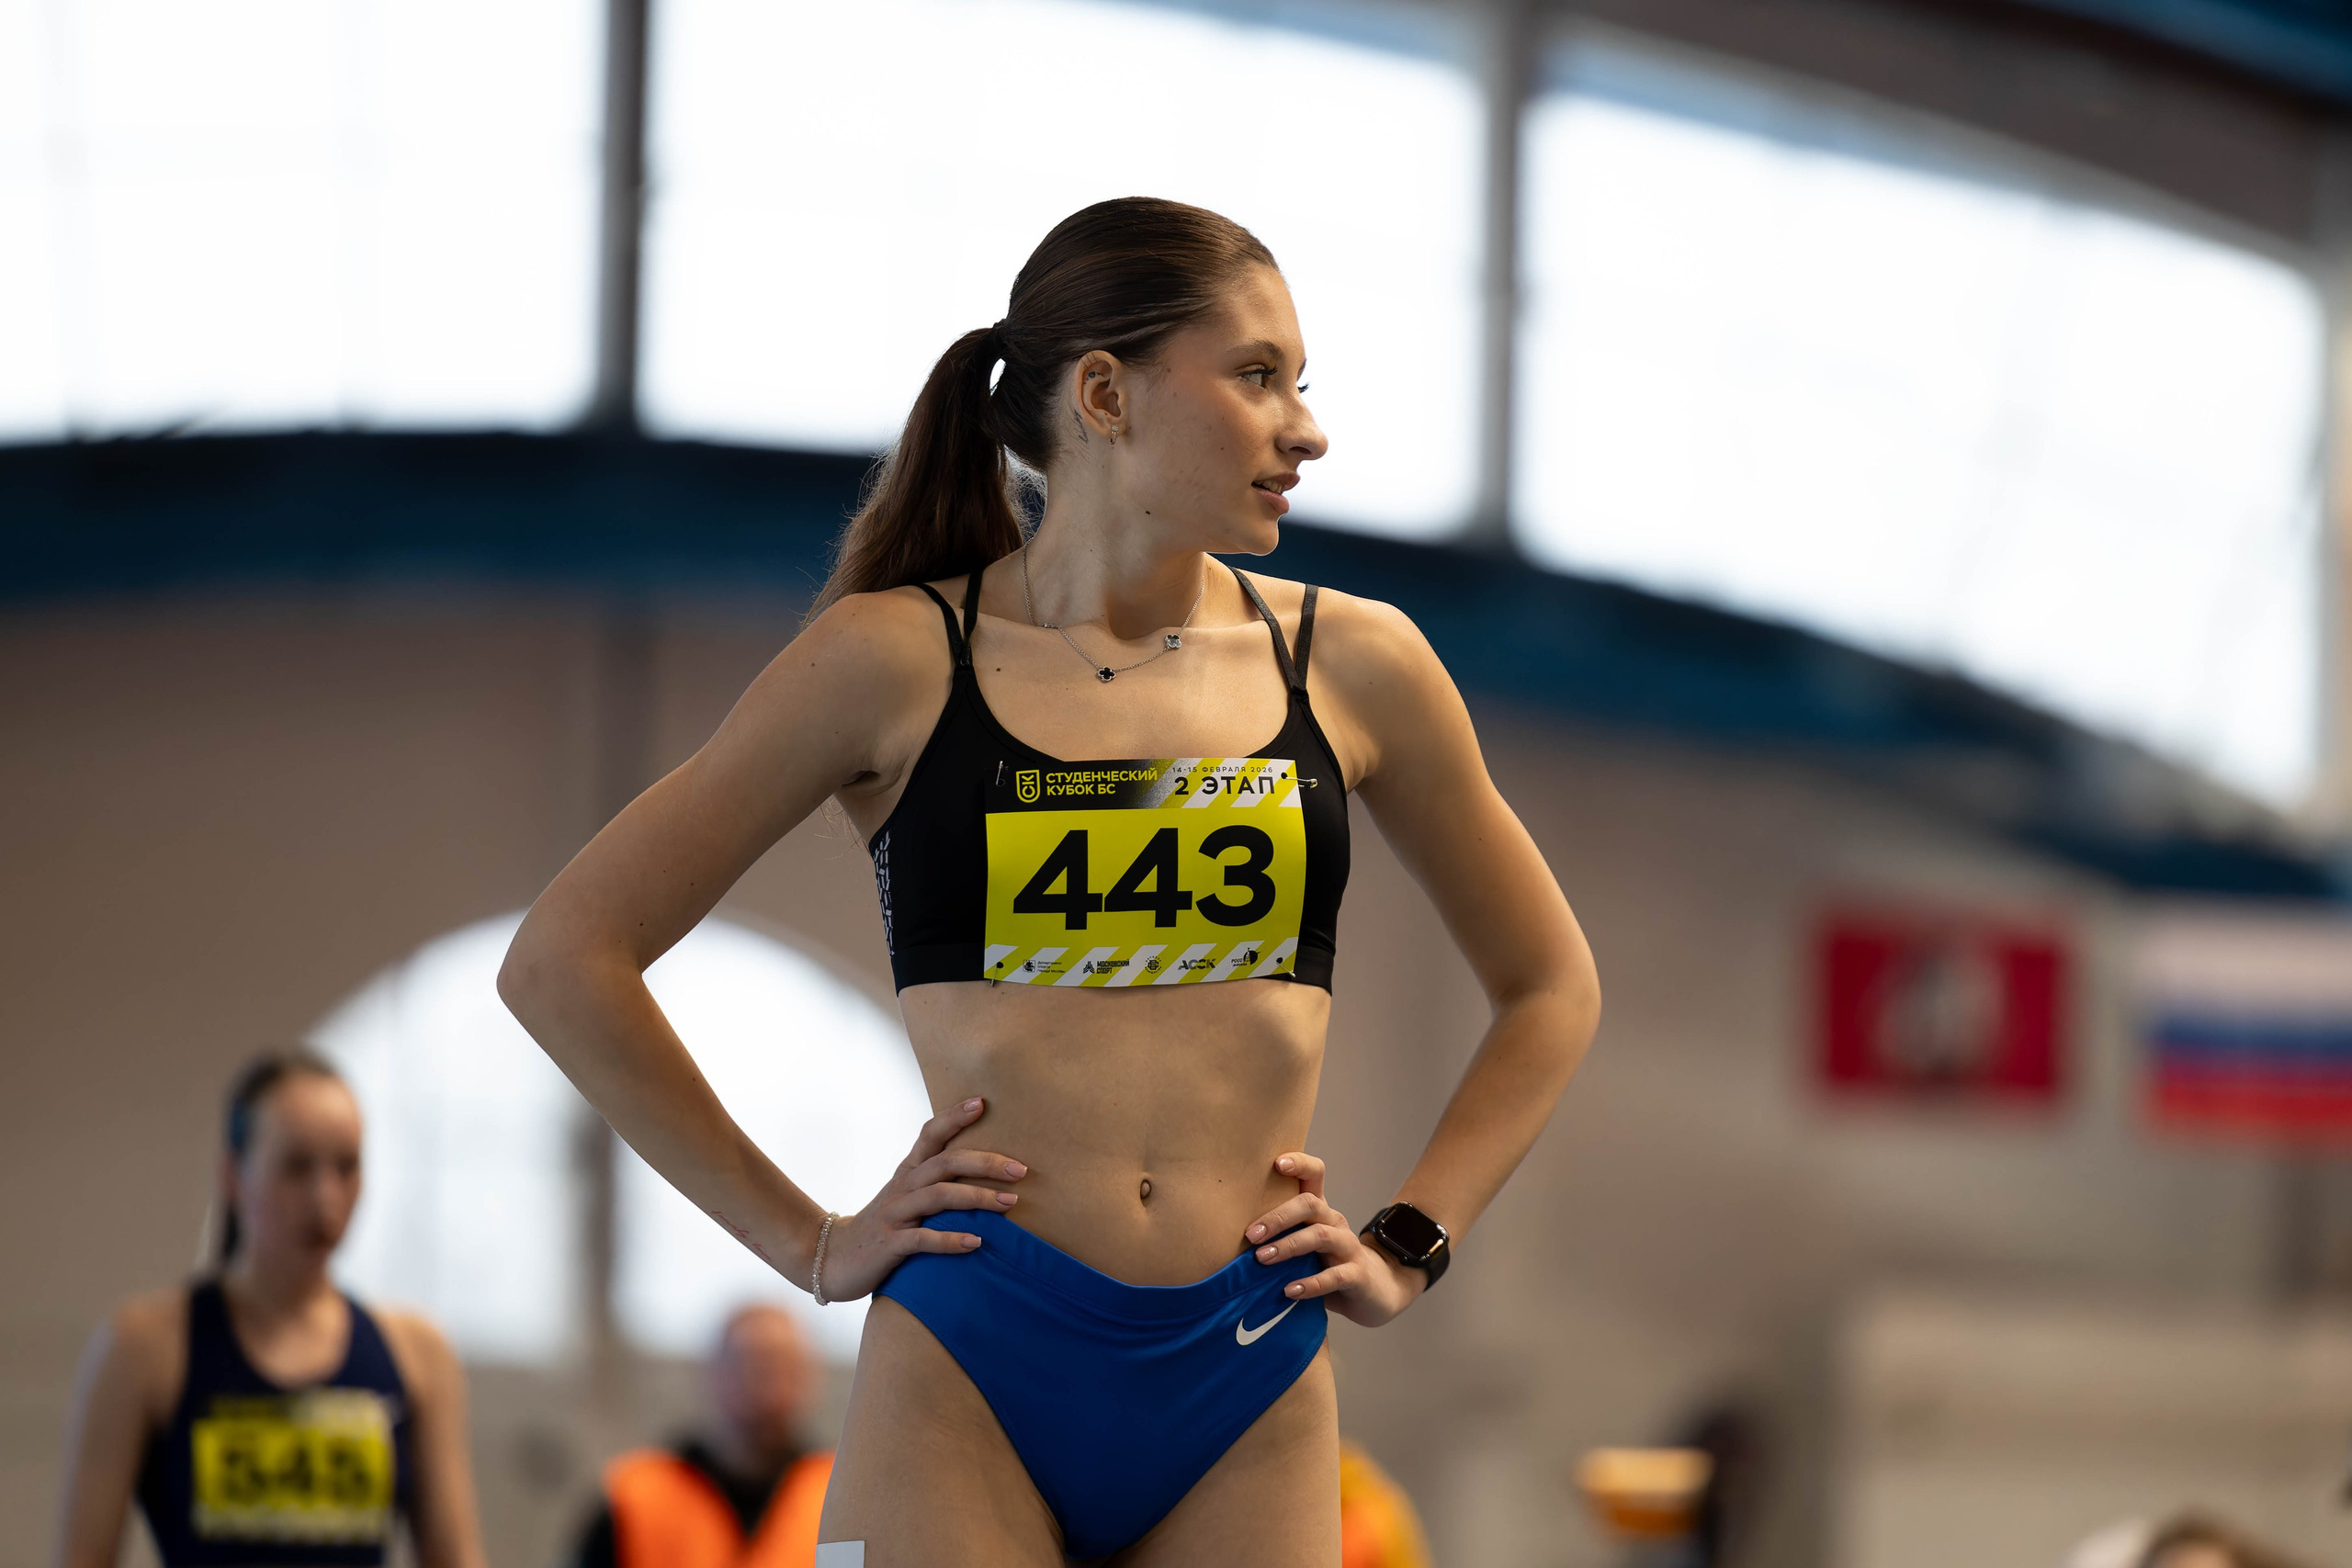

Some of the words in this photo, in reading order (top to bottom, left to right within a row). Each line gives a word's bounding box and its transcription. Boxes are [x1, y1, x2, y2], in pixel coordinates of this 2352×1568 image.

[1046, 767, 1158, 784] СТУДЕНЧЕСКИЙ
[1046, 784, 1094, 796] КУБОК
[1098, 784, 1116, 795] БС
[1174, 777, 1189, 795] 2
[1201, 776, 1275, 795] ЭТАП
[1012, 825, 1276, 931] 443
